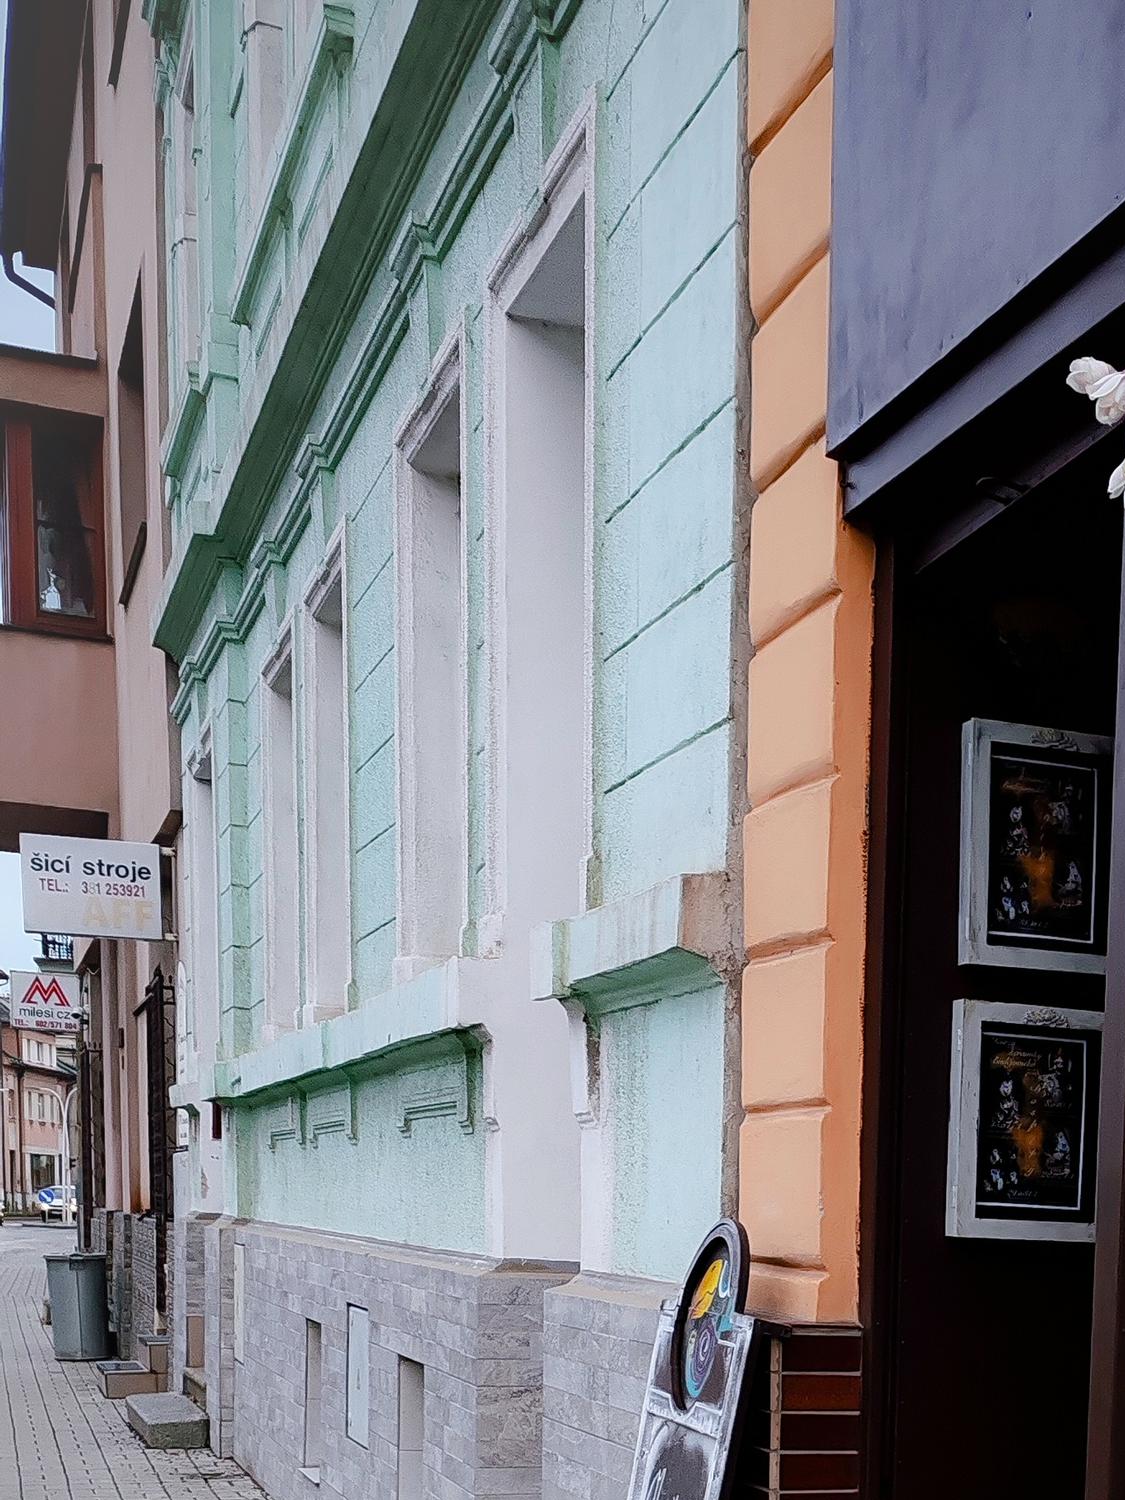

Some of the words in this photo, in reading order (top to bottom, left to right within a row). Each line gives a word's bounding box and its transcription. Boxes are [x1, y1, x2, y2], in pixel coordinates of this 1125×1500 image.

[30, 852, 72, 874] šicí
[82, 858, 152, 883] stroje
[105, 882, 146, 898] 253921
[19, 1006, 54, 1018] milesi
